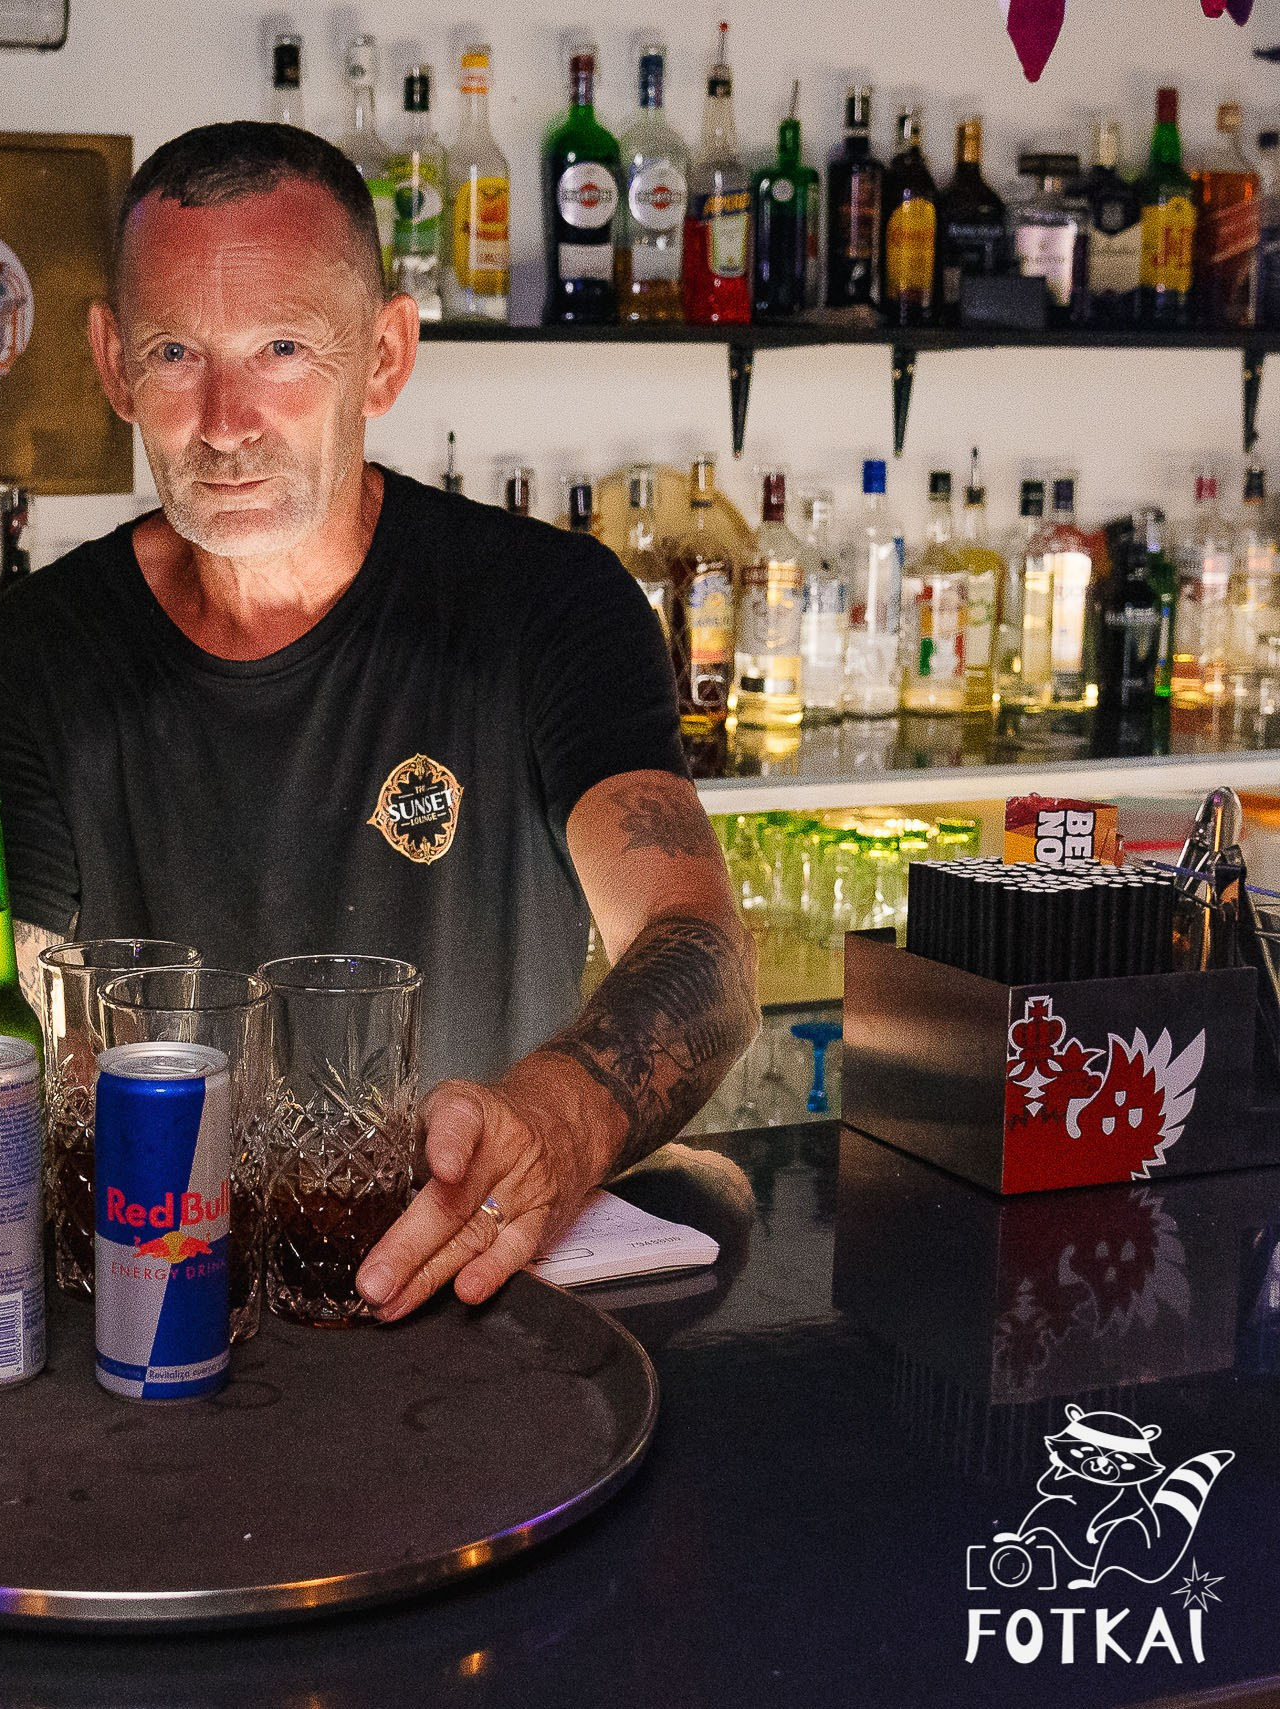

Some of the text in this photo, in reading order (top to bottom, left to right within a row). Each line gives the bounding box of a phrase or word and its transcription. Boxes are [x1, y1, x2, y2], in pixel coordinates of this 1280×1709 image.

[387, 788, 453, 823] SUNSET
[411, 812, 438, 826] LOUNGE
[1064, 810, 1095, 866] BE
[106, 1178, 230, 1228] Red Bull
[111, 1261, 179, 1280] ENERGY
[148, 1368, 191, 1381] Revitaliza
